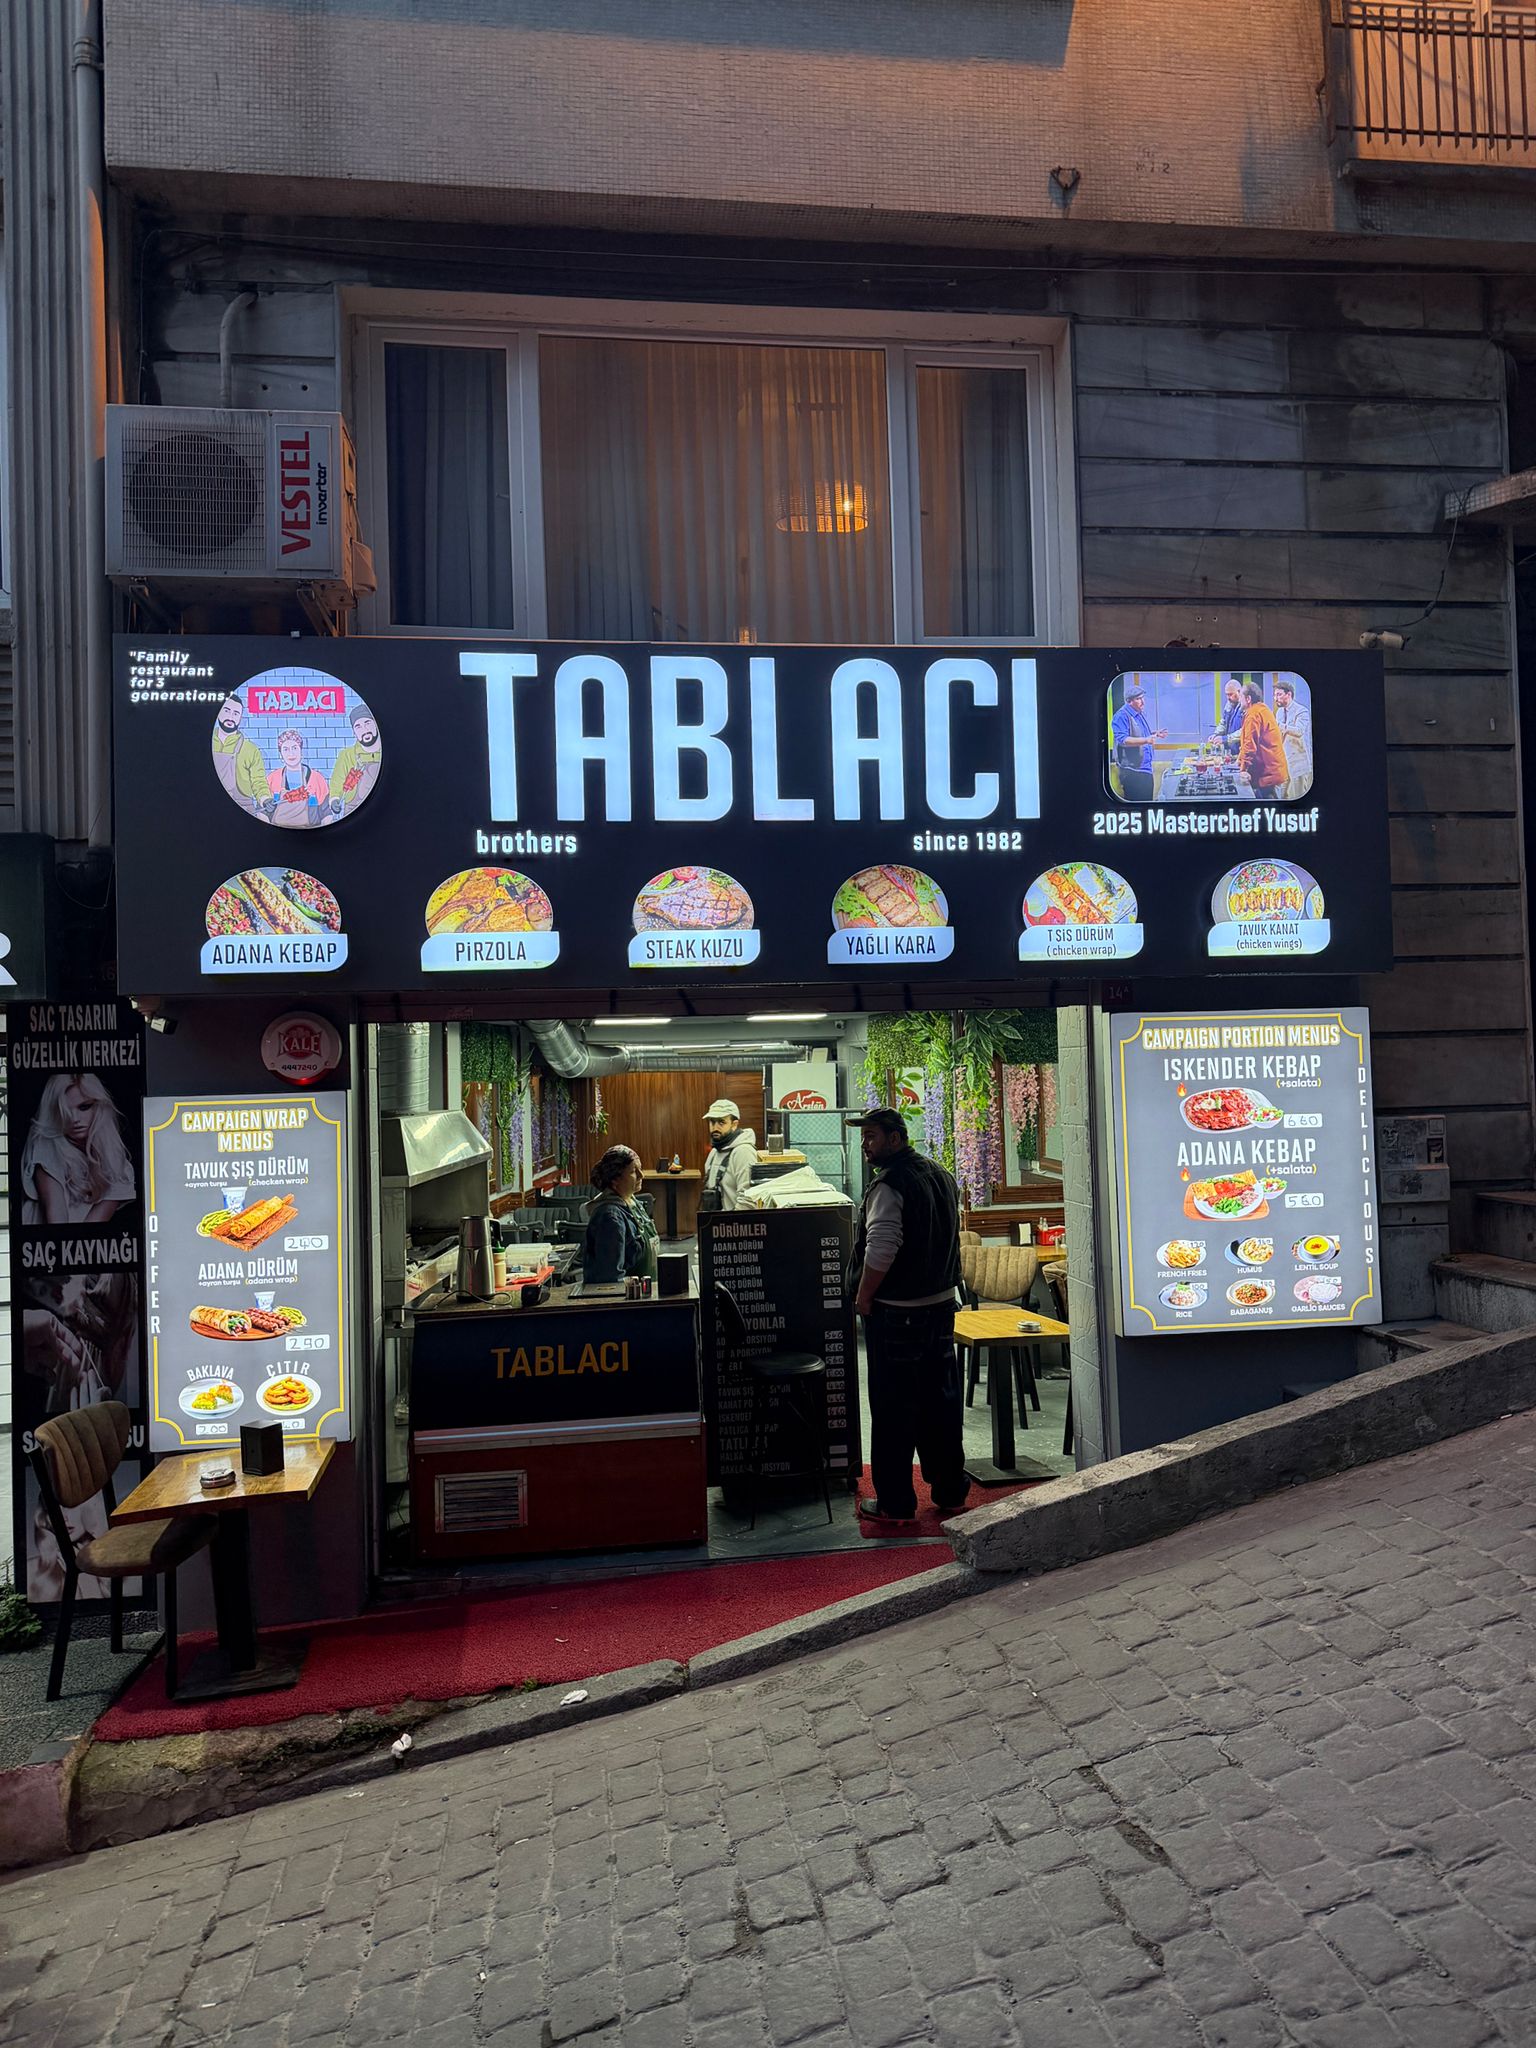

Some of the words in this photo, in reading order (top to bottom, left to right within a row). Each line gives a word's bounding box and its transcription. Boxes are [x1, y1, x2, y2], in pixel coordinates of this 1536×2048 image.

[280, 431, 312, 555] VESTEL
[316, 462, 328, 525] inverter
[129, 651, 190, 665] "Family
[131, 666, 214, 676] restaurant
[130, 677, 154, 688] for
[156, 677, 165, 688] 3
[255, 690, 336, 712] TABLACI
[460, 653, 1040, 821] TABLACI
[1093, 812, 1142, 834] 2025
[1147, 808, 1262, 834] Masterchef
[1263, 808, 1319, 833] Yusuf
[476, 829, 578, 854] brothers
[913, 830, 969, 851] since
[976, 831, 1022, 851] 1982
[1047, 929, 1053, 942] T
[1075, 926, 1115, 942] DÜRÜM
[1237, 924, 1268, 936] TAVUK
[1269, 923, 1299, 936] KANAT
[212, 943, 273, 965] ADANA
[279, 942, 338, 963] KEBAP
[646, 939, 697, 960] STEAK
[701, 938, 743, 958] KUZU
[846, 933, 890, 956] YAĞLI
[894, 935, 937, 955] KARA
[1090, 943, 1118, 958] wrap)
[1236, 939, 1272, 951] (chicken
[1273, 938, 1303, 951] wings)
[58, 1004, 118, 1031] TASARIM
[278, 1031, 322, 1056] KALE
[1142, 1029, 1220, 1050] CAMPAIGN
[1222, 1027, 1285, 1049] PORTION
[1287, 1025, 1341, 1047] MENUS
[12, 1035, 79, 1069] GÜZELLİK
[81, 1033, 140, 1068] MERKEZİ
[1163, 1057, 1256, 1081] ISKENDER
[1262, 1055, 1321, 1078] KEBAP
[1276, 1079, 1322, 1089] (+salata)
[182, 1110, 262, 1132] CAMPAIGN
[262, 1108, 309, 1130] WRAP
[218, 1131, 273, 1152] MENUS
[1177, 1141, 1246, 1167] ADANA
[1251, 1139, 1316, 1163] KEBAP
[184, 1161, 229, 1180] TAVUK
[258, 1156, 309, 1177] DÜRÜM
[1266, 1163, 1317, 1175] (+salata)
[1358, 1067, 1374, 1264] DELICIOUS
[712, 1222, 767, 1239] DÜRÜMLER
[22, 1240, 57, 1273] SAÇ
[61, 1231, 138, 1266] KAYNAĞI
[712, 1242, 737, 1252] ADANA
[738, 1239, 764, 1251] DÜRÜM
[198, 1262, 244, 1281] ADANA
[247, 1256, 298, 1278] DÜRÜM
[713, 1254, 732, 1265] URFA
[733, 1252, 759, 1264] DÜRÜM
[1319, 1262, 1339, 1270] SOUP
[149, 1215, 161, 1334] OFFER
[736, 1265, 761, 1276] DÜRÜM
[1157, 1270, 1187, 1278] FRENCH
[1237, 1266, 1263, 1274] HUMUS
[737, 1277, 763, 1289] DÜRÜM
[739, 1289, 765, 1301] DÜRÜM
[750, 1302, 777, 1313] DÜRÜM
[1318, 1303, 1346, 1312] SAUCES
[490, 1341, 630, 1379] TABLACI
[186, 1364, 235, 1382] BAKLAVA
